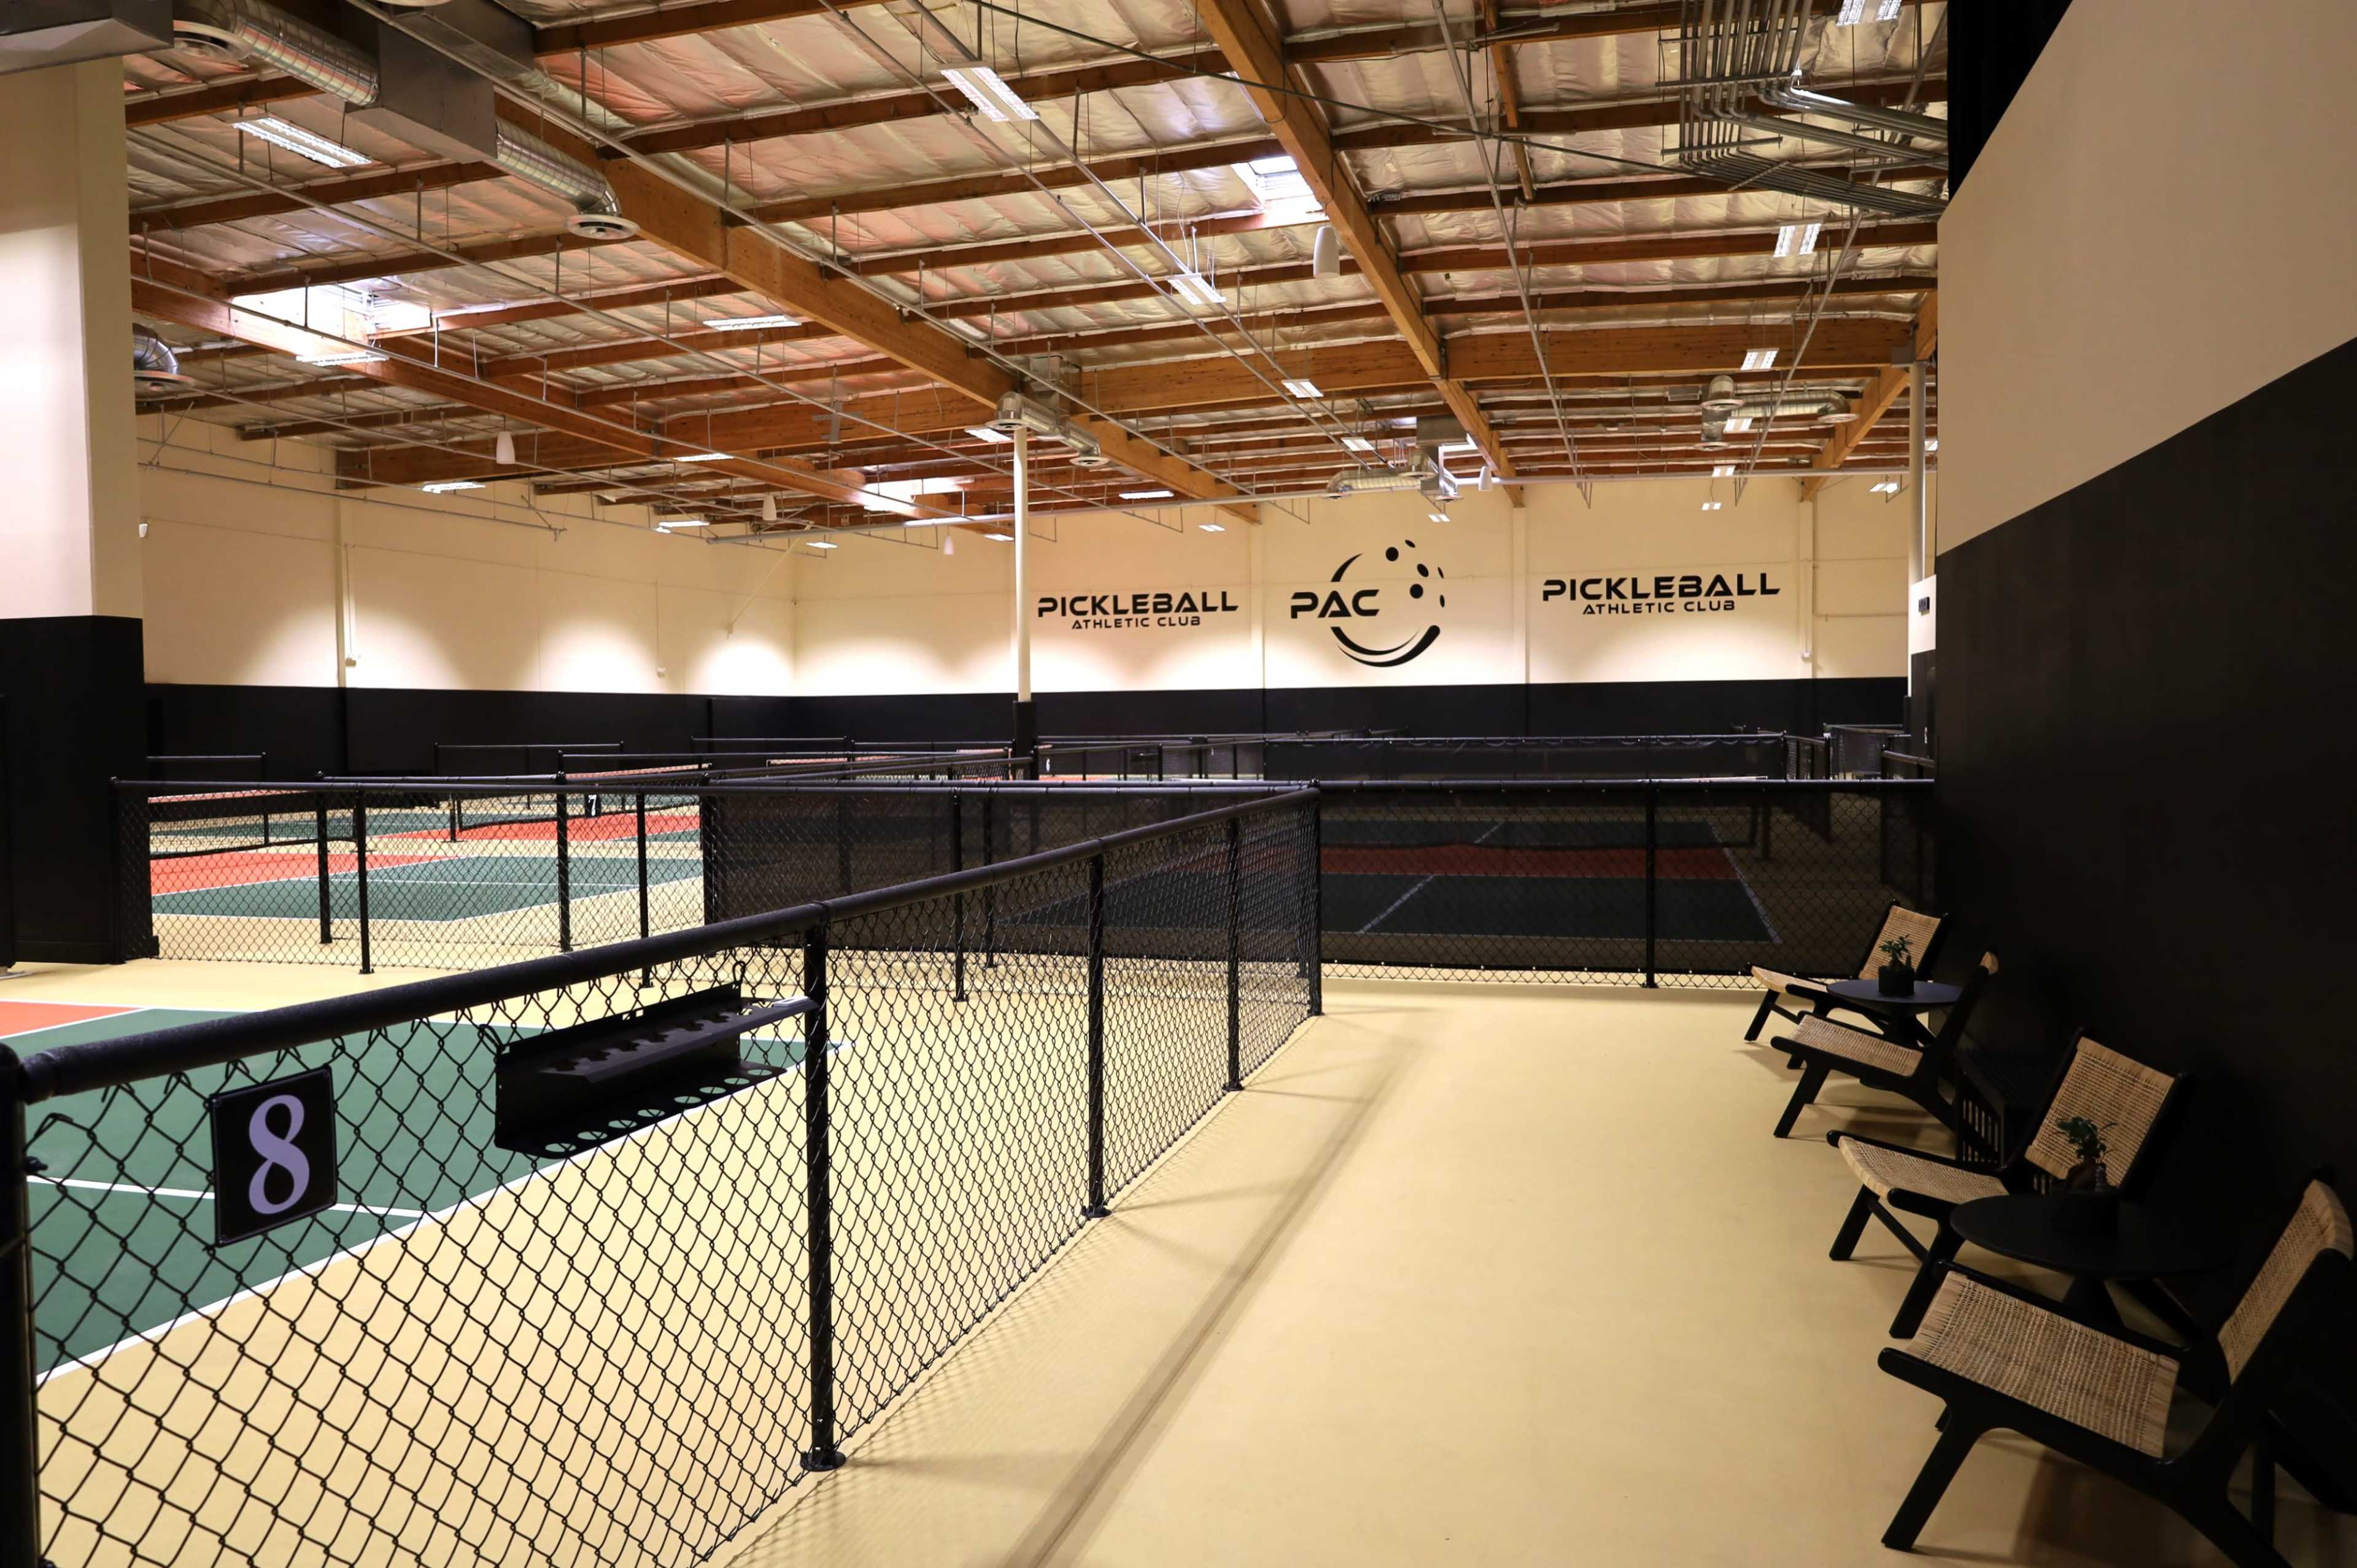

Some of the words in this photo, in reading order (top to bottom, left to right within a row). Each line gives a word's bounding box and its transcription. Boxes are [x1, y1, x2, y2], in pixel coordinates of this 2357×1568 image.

[1542, 573, 1781, 601] PICKLEBALL
[1038, 591, 1239, 617] PICKLEBALL
[1290, 589, 1379, 619] PAC
[1582, 601, 1675, 615] ATHLETIC
[1683, 599, 1736, 612] CLUB
[1071, 617, 1150, 630] ATHLETIC
[1156, 615, 1201, 627] CLUB
[587, 794, 598, 817] 7
[248, 1094, 310, 1215] 8
